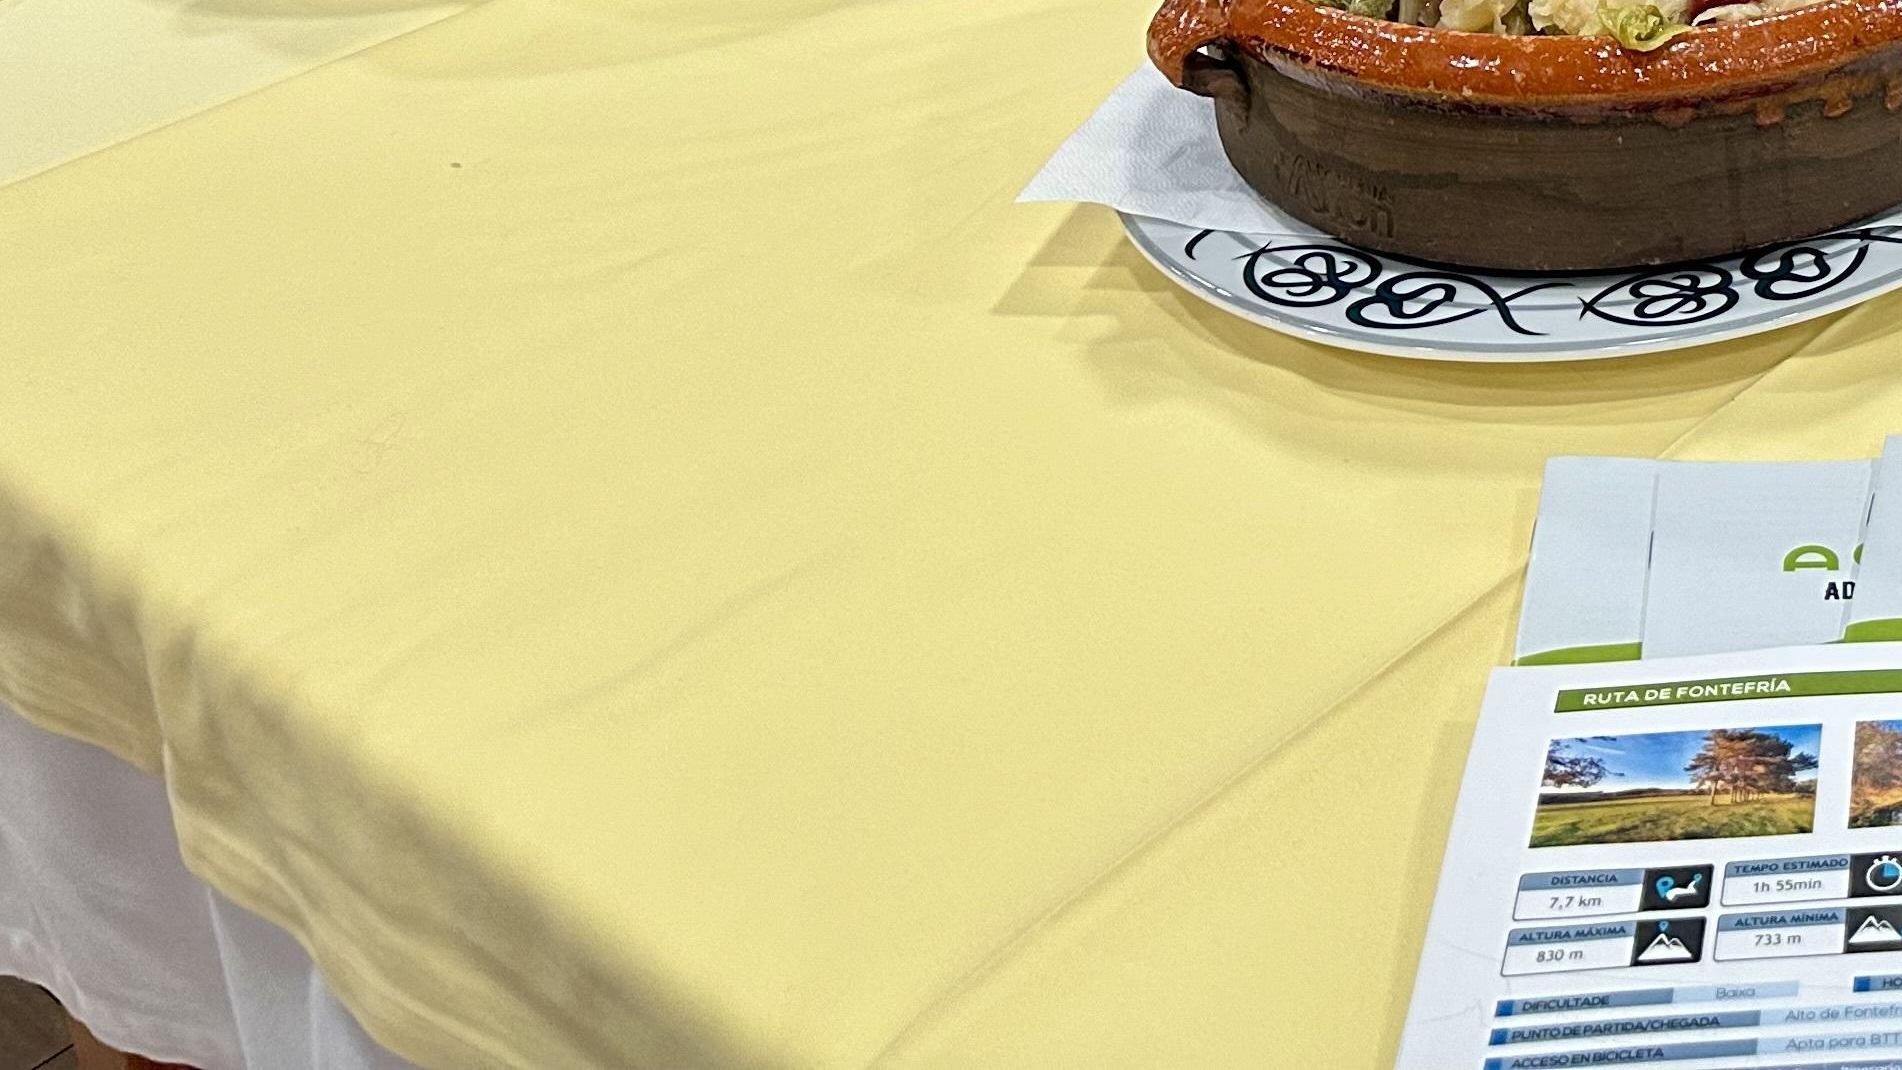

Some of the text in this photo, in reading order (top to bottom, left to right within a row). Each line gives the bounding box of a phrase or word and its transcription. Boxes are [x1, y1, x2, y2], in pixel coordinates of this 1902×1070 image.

[1583, 677, 1793, 706] RUTA DE FONTEFRÍA
[1734, 858, 1848, 874] TEMPO ESTIMADO
[1550, 874, 1618, 885] DISTANCIA
[1753, 878, 1822, 893] 1h 55min
[1549, 894, 1602, 910] 7,7 km
[1734, 911, 1839, 927] ALTURA MÍNIMA
[1519, 924, 1627, 943] ALTURA MÁXIMA
[1755, 933, 1801, 946] 733 m
[1536, 949, 1583, 962] 830 m
[1715, 987, 1756, 1000] Baixa
[1522, 995, 1610, 1012] DIFICULTADE
[1785, 1009, 1816, 1022] Alto
[1819, 1008, 1840, 1021] de
[1511, 1015, 1721, 1042] PUNTO DE PARTIDA/CHEGADA
[1785, 1032, 1902, 1052] Apta para BTT
[1511, 1047, 1665, 1069] ACCESO EN BICICLETA
